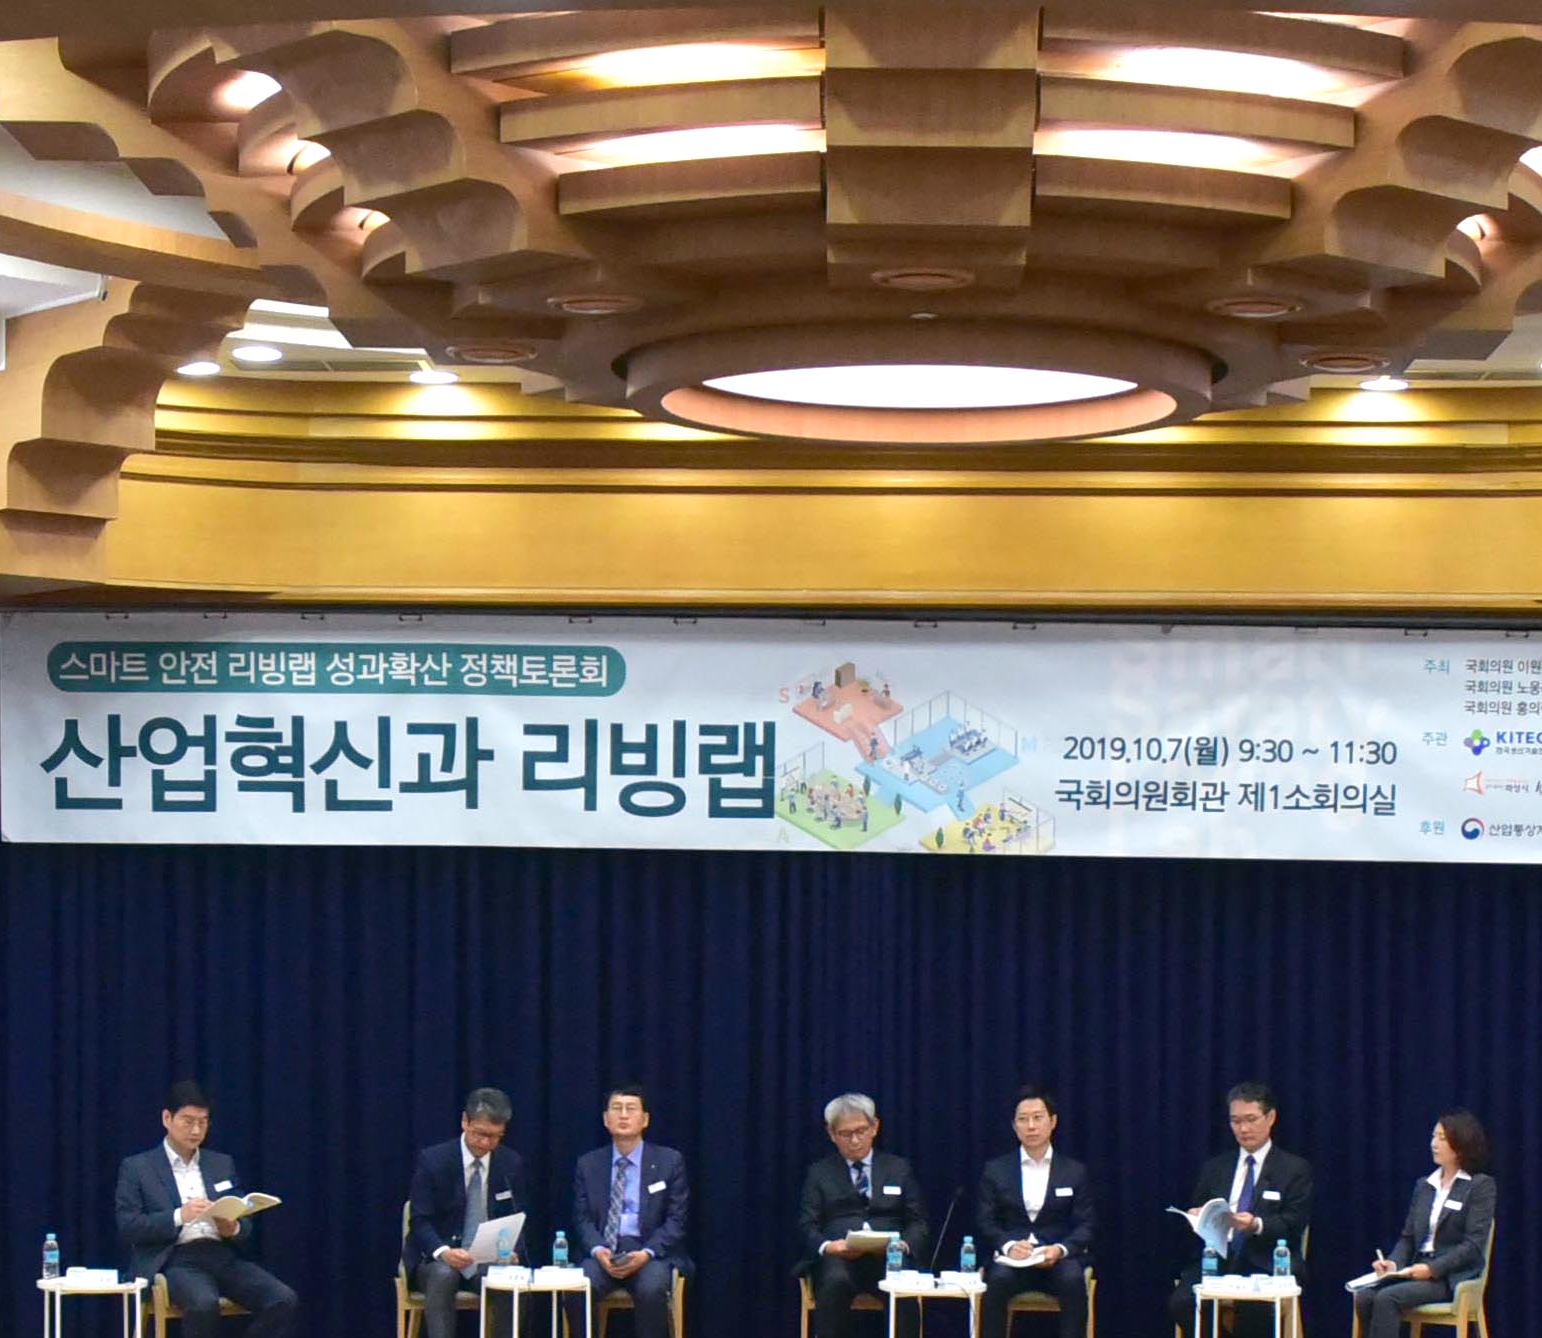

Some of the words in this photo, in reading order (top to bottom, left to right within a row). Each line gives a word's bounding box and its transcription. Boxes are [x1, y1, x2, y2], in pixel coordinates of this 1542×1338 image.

[59, 651, 150, 684] 스마트
[159, 651, 218, 685] 안전
[228, 652, 317, 686] 리빙랩
[326, 652, 453, 687] 성과확산
[460, 654, 607, 688] 정책토론회
[1424, 659, 1450, 674] 주최
[1465, 659, 1513, 674] 국회의원
[1465, 680, 1513, 695] 국회의원
[1464, 701, 1512, 716] 국회의원
[1422, 731, 1448, 747] 주관
[1063, 736, 1230, 767] 2019.10.7(월)
[1239, 738, 1294, 763] 9:30
[1330, 740, 1398, 765] 11:30
[39, 713, 495, 813] 산업혁신과
[522, 718, 777, 819] 리빙랩
[1054, 779, 1230, 813] 국회의원회관
[1237, 781, 1397, 817] 제1소회의실
[1419, 820, 1445, 836] 후원
